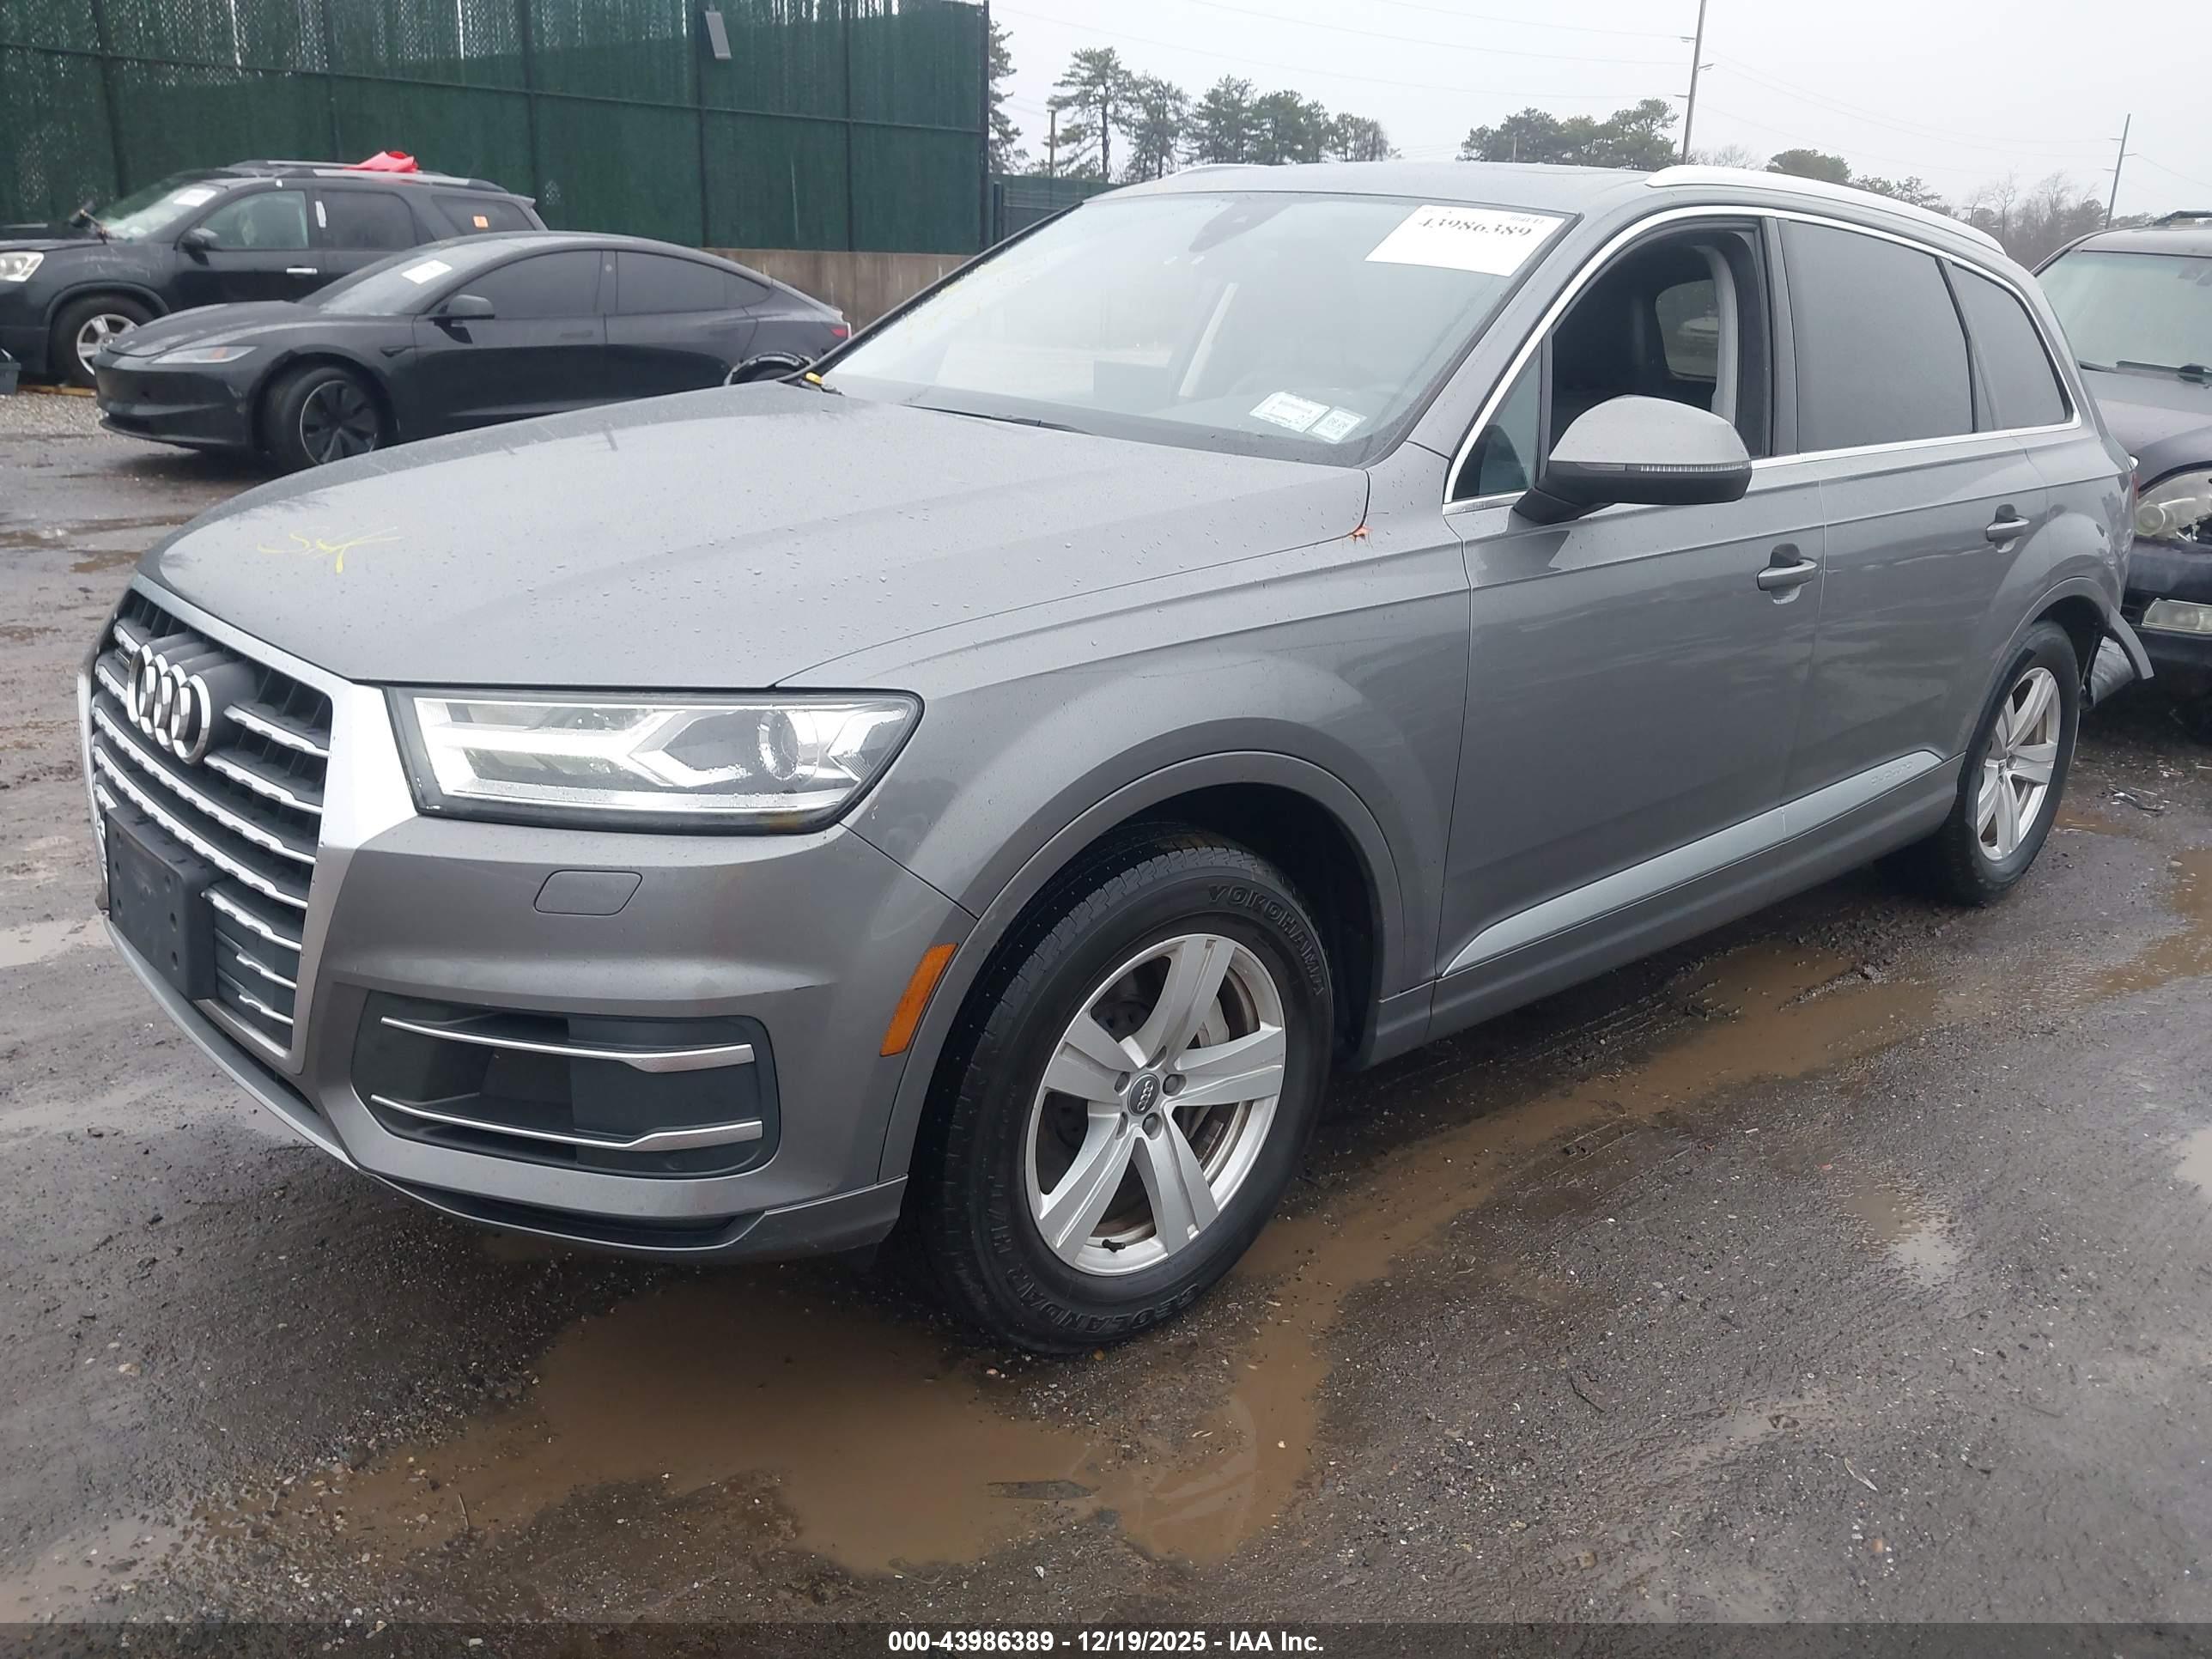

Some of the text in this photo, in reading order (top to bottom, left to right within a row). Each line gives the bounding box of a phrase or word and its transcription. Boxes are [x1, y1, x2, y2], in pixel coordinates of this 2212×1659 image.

[1418, 217, 1532, 236] 43986389
[1208, 884, 1325, 997] YOKOHAMA
[1006, 1264, 1201, 1334] GEOLANDAR
